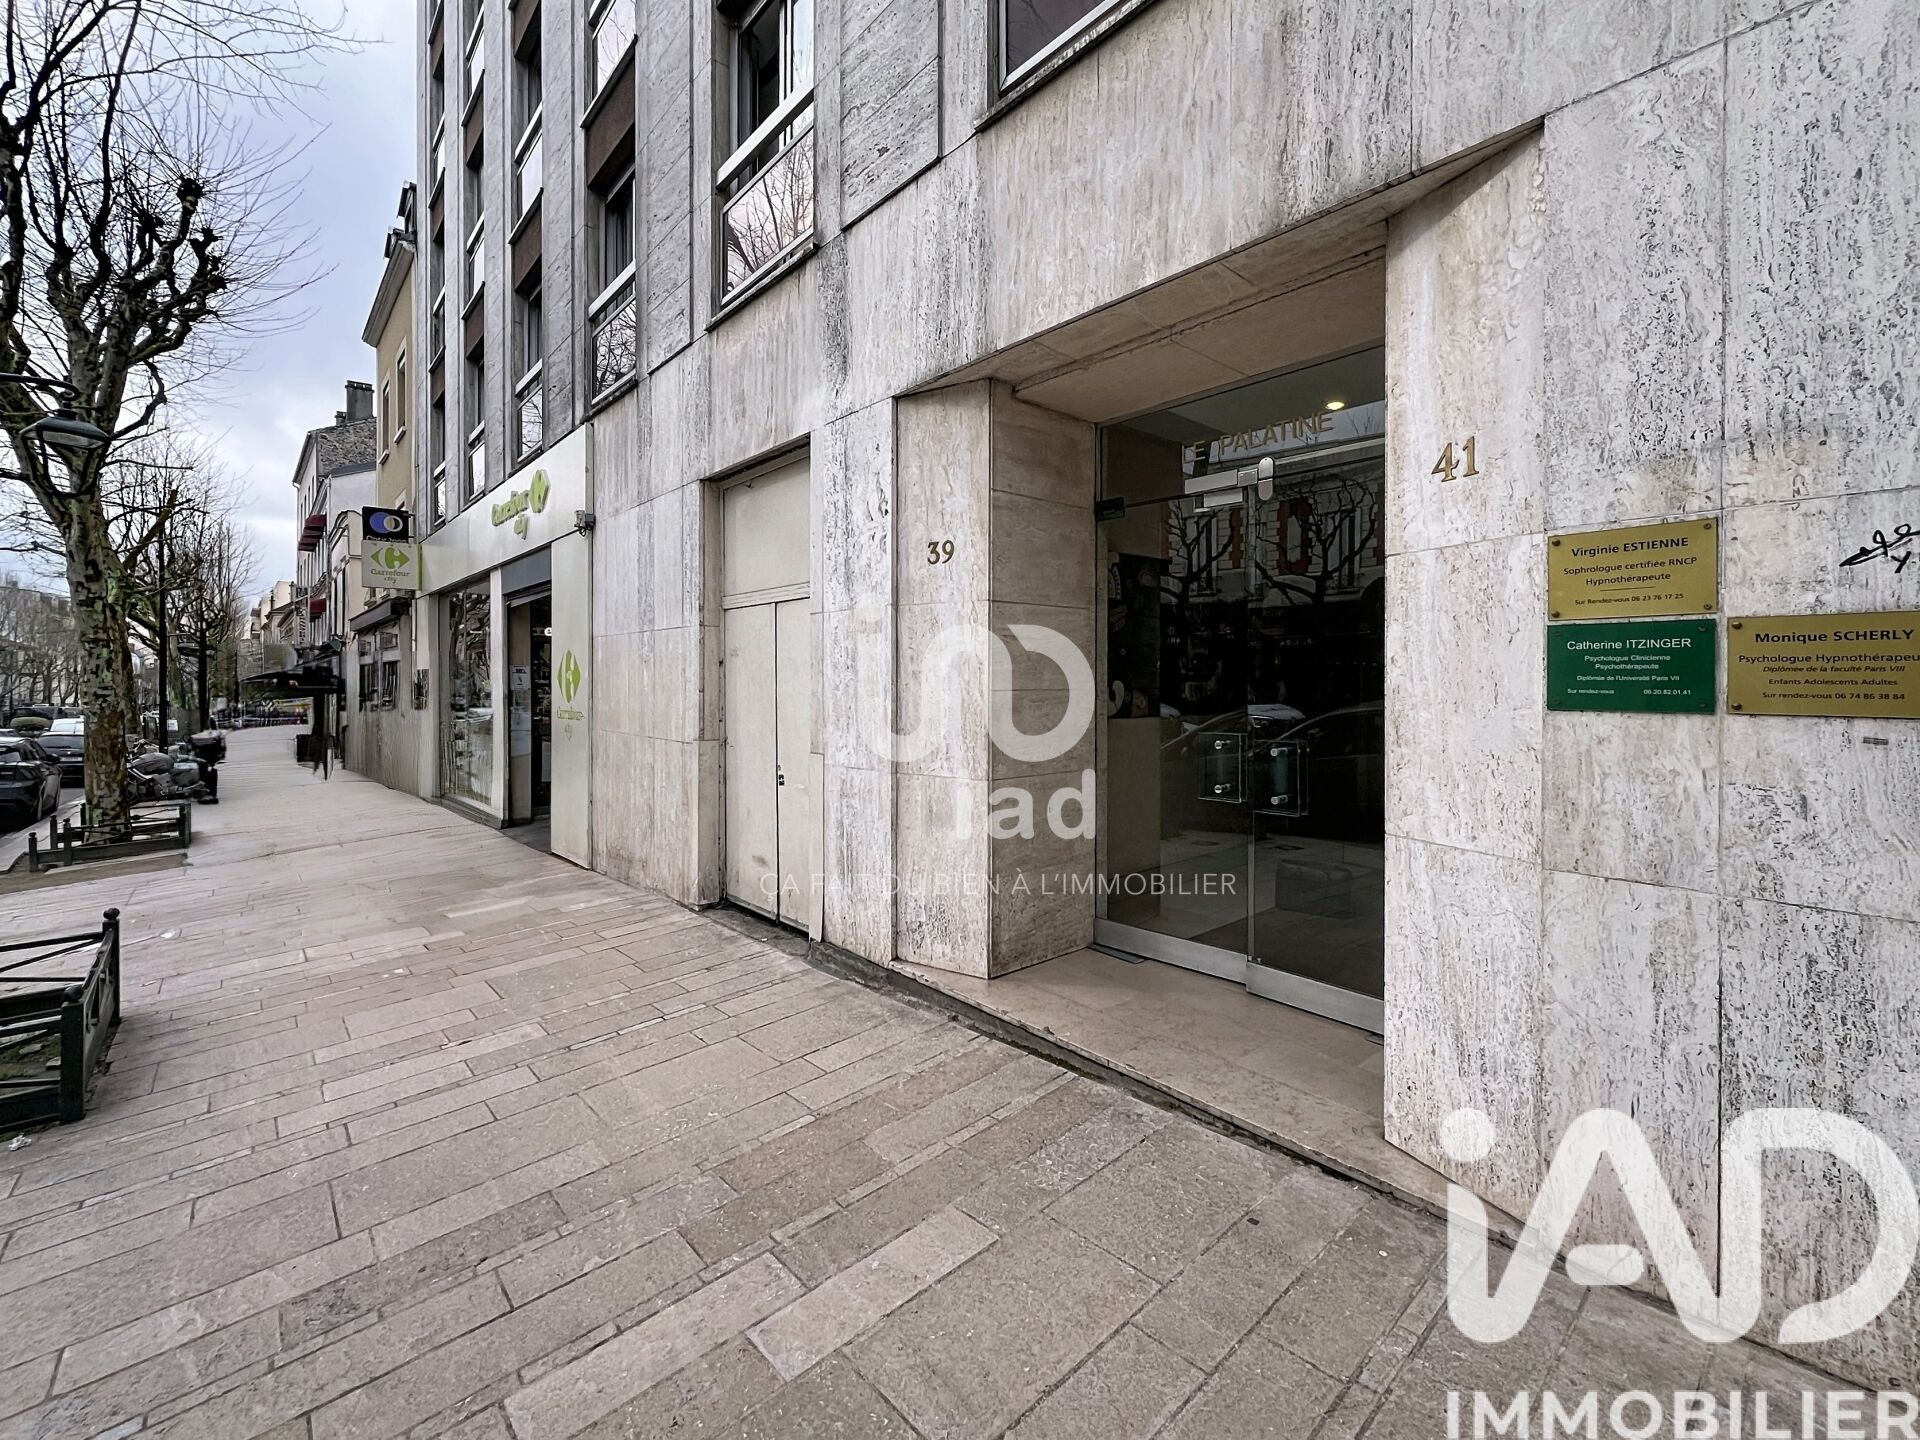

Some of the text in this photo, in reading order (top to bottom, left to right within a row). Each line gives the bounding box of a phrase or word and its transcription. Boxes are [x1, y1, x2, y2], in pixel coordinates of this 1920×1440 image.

[1182, 410, 1335, 465] LE PALATINE
[1430, 435, 1480, 483] 41
[927, 539, 955, 565] 39
[1572, 537, 1689, 557] Virginie ESTIENNE
[370, 568, 410, 577] Carrefour
[1564, 556, 1697, 575] Sophrologue certifiée RNCP
[1586, 573, 1671, 586] Hypnothérapeute
[1567, 638, 1692, 649] Catherine ITZINGER
[1755, 629, 1915, 644] Monique SCHERLY
[1739, 655, 1811, 664] Psychologue
